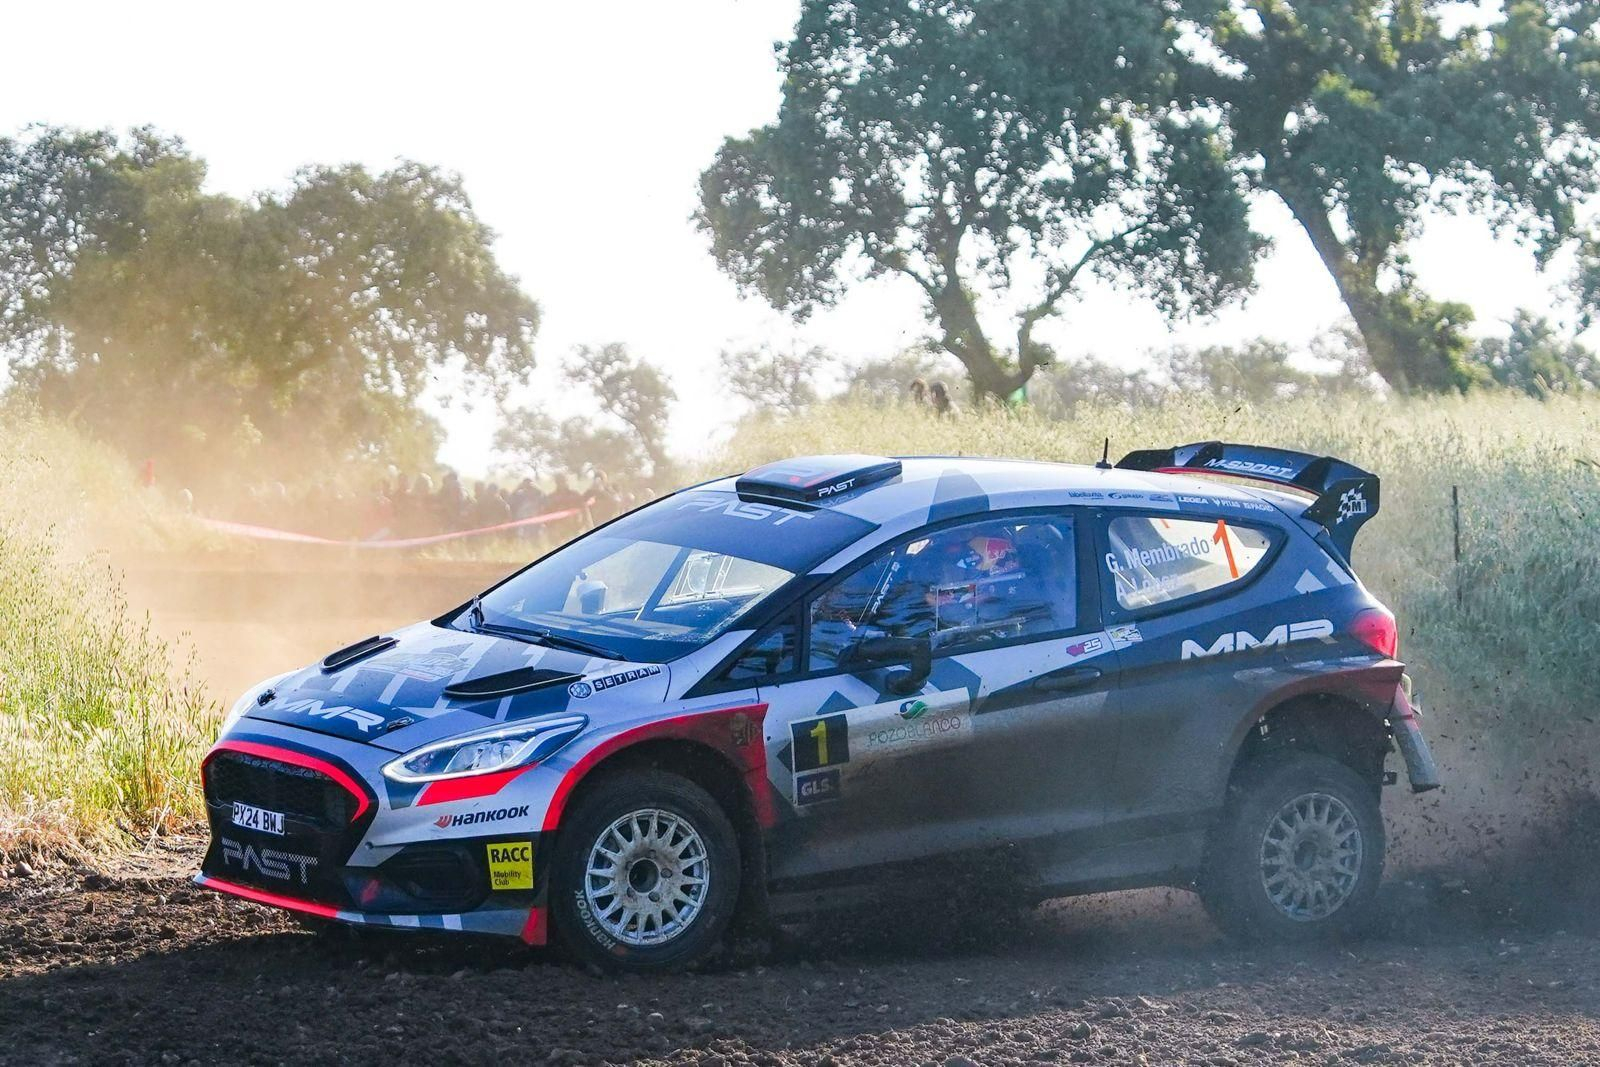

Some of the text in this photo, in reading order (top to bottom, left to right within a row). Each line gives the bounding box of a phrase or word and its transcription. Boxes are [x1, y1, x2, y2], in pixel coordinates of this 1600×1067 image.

[1204, 458, 1296, 478] M-SPORT
[817, 478, 856, 497] PAST
[677, 498, 815, 526] PAST
[1105, 537, 1209, 573] G. Membrado
[1212, 519, 1239, 578] 1
[1181, 619, 1338, 660] MMR
[594, 665, 661, 691] SETRAM
[810, 720, 828, 765] 1
[233, 804, 284, 834] PX24 BWJ
[222, 836, 318, 884] PAST
[491, 847, 529, 863] RACC
[494, 870, 521, 880] Mobility
